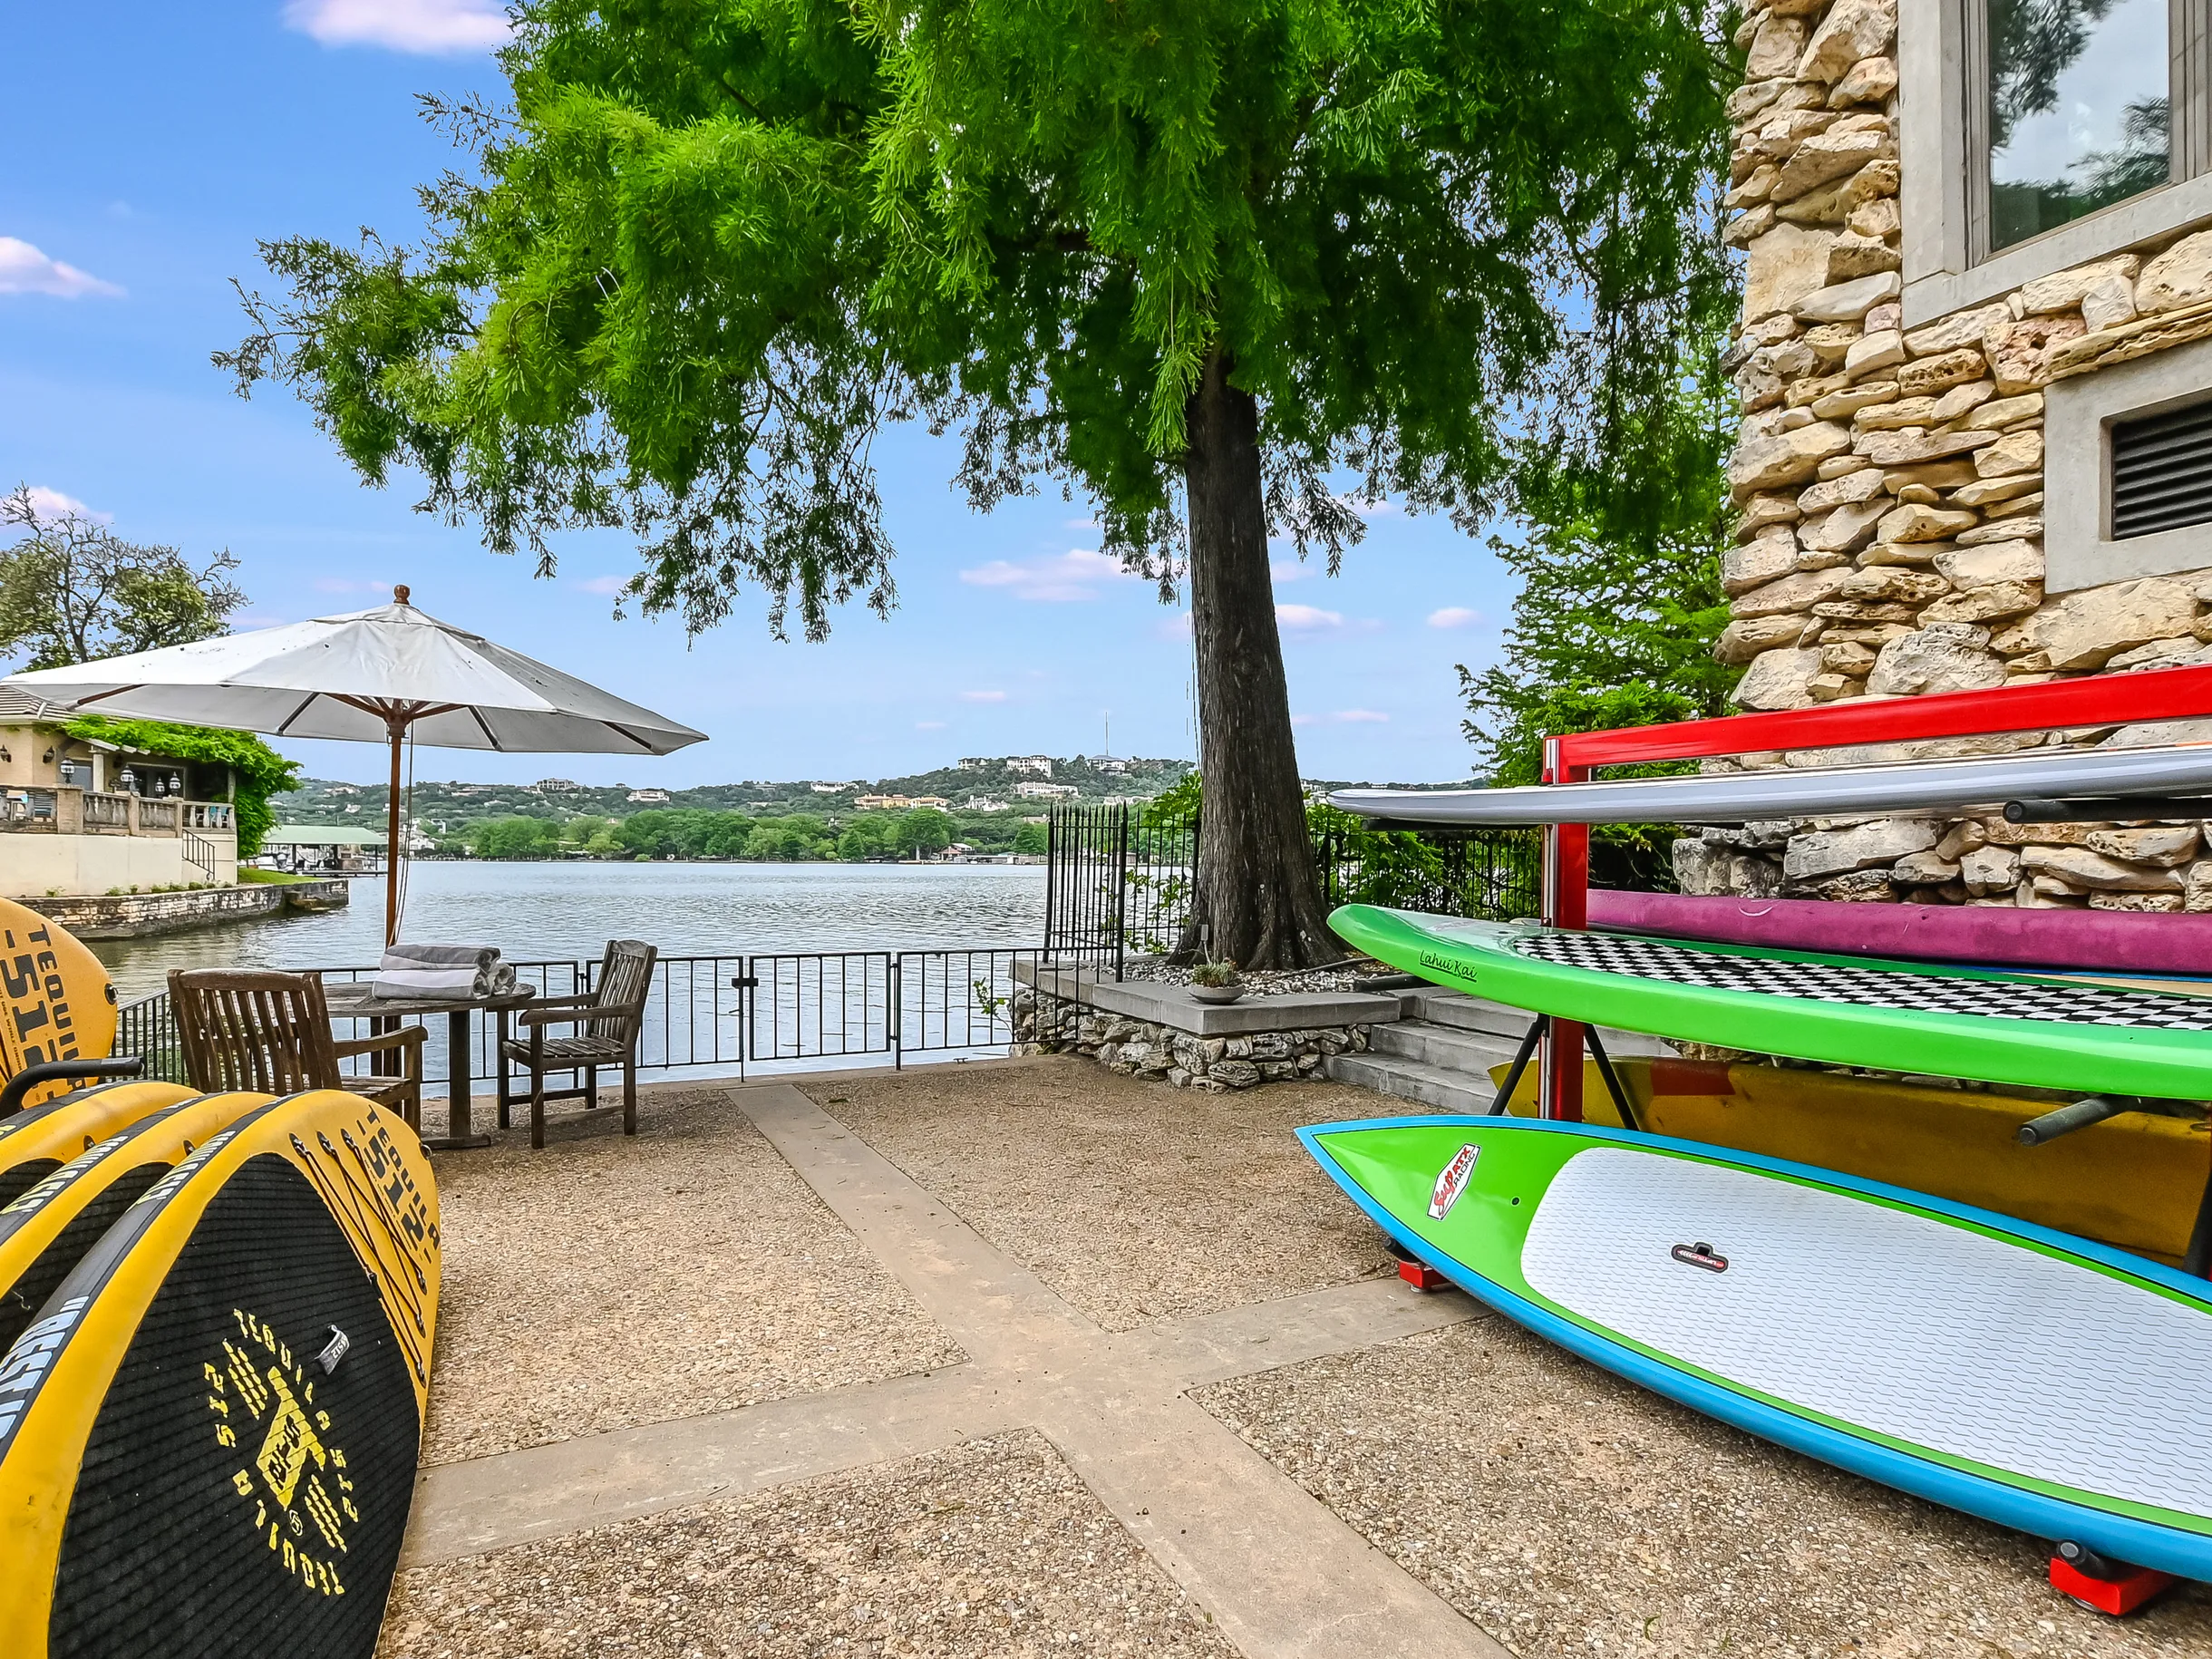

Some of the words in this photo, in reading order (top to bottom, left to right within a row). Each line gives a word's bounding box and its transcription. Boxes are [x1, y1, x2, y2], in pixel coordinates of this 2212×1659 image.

[1420, 950, 1452, 971] Lahui
[1454, 961, 1477, 978] Kai
[367, 1104, 440, 1250] TEQUILA
[1452, 1147, 1470, 1175] ATX
[1454, 1153, 1475, 1188] RACING
[233, 1308, 330, 1431] TEQUILA
[330, 1449, 359, 1523] 512
[233, 1470, 344, 1596] TEQUILA
